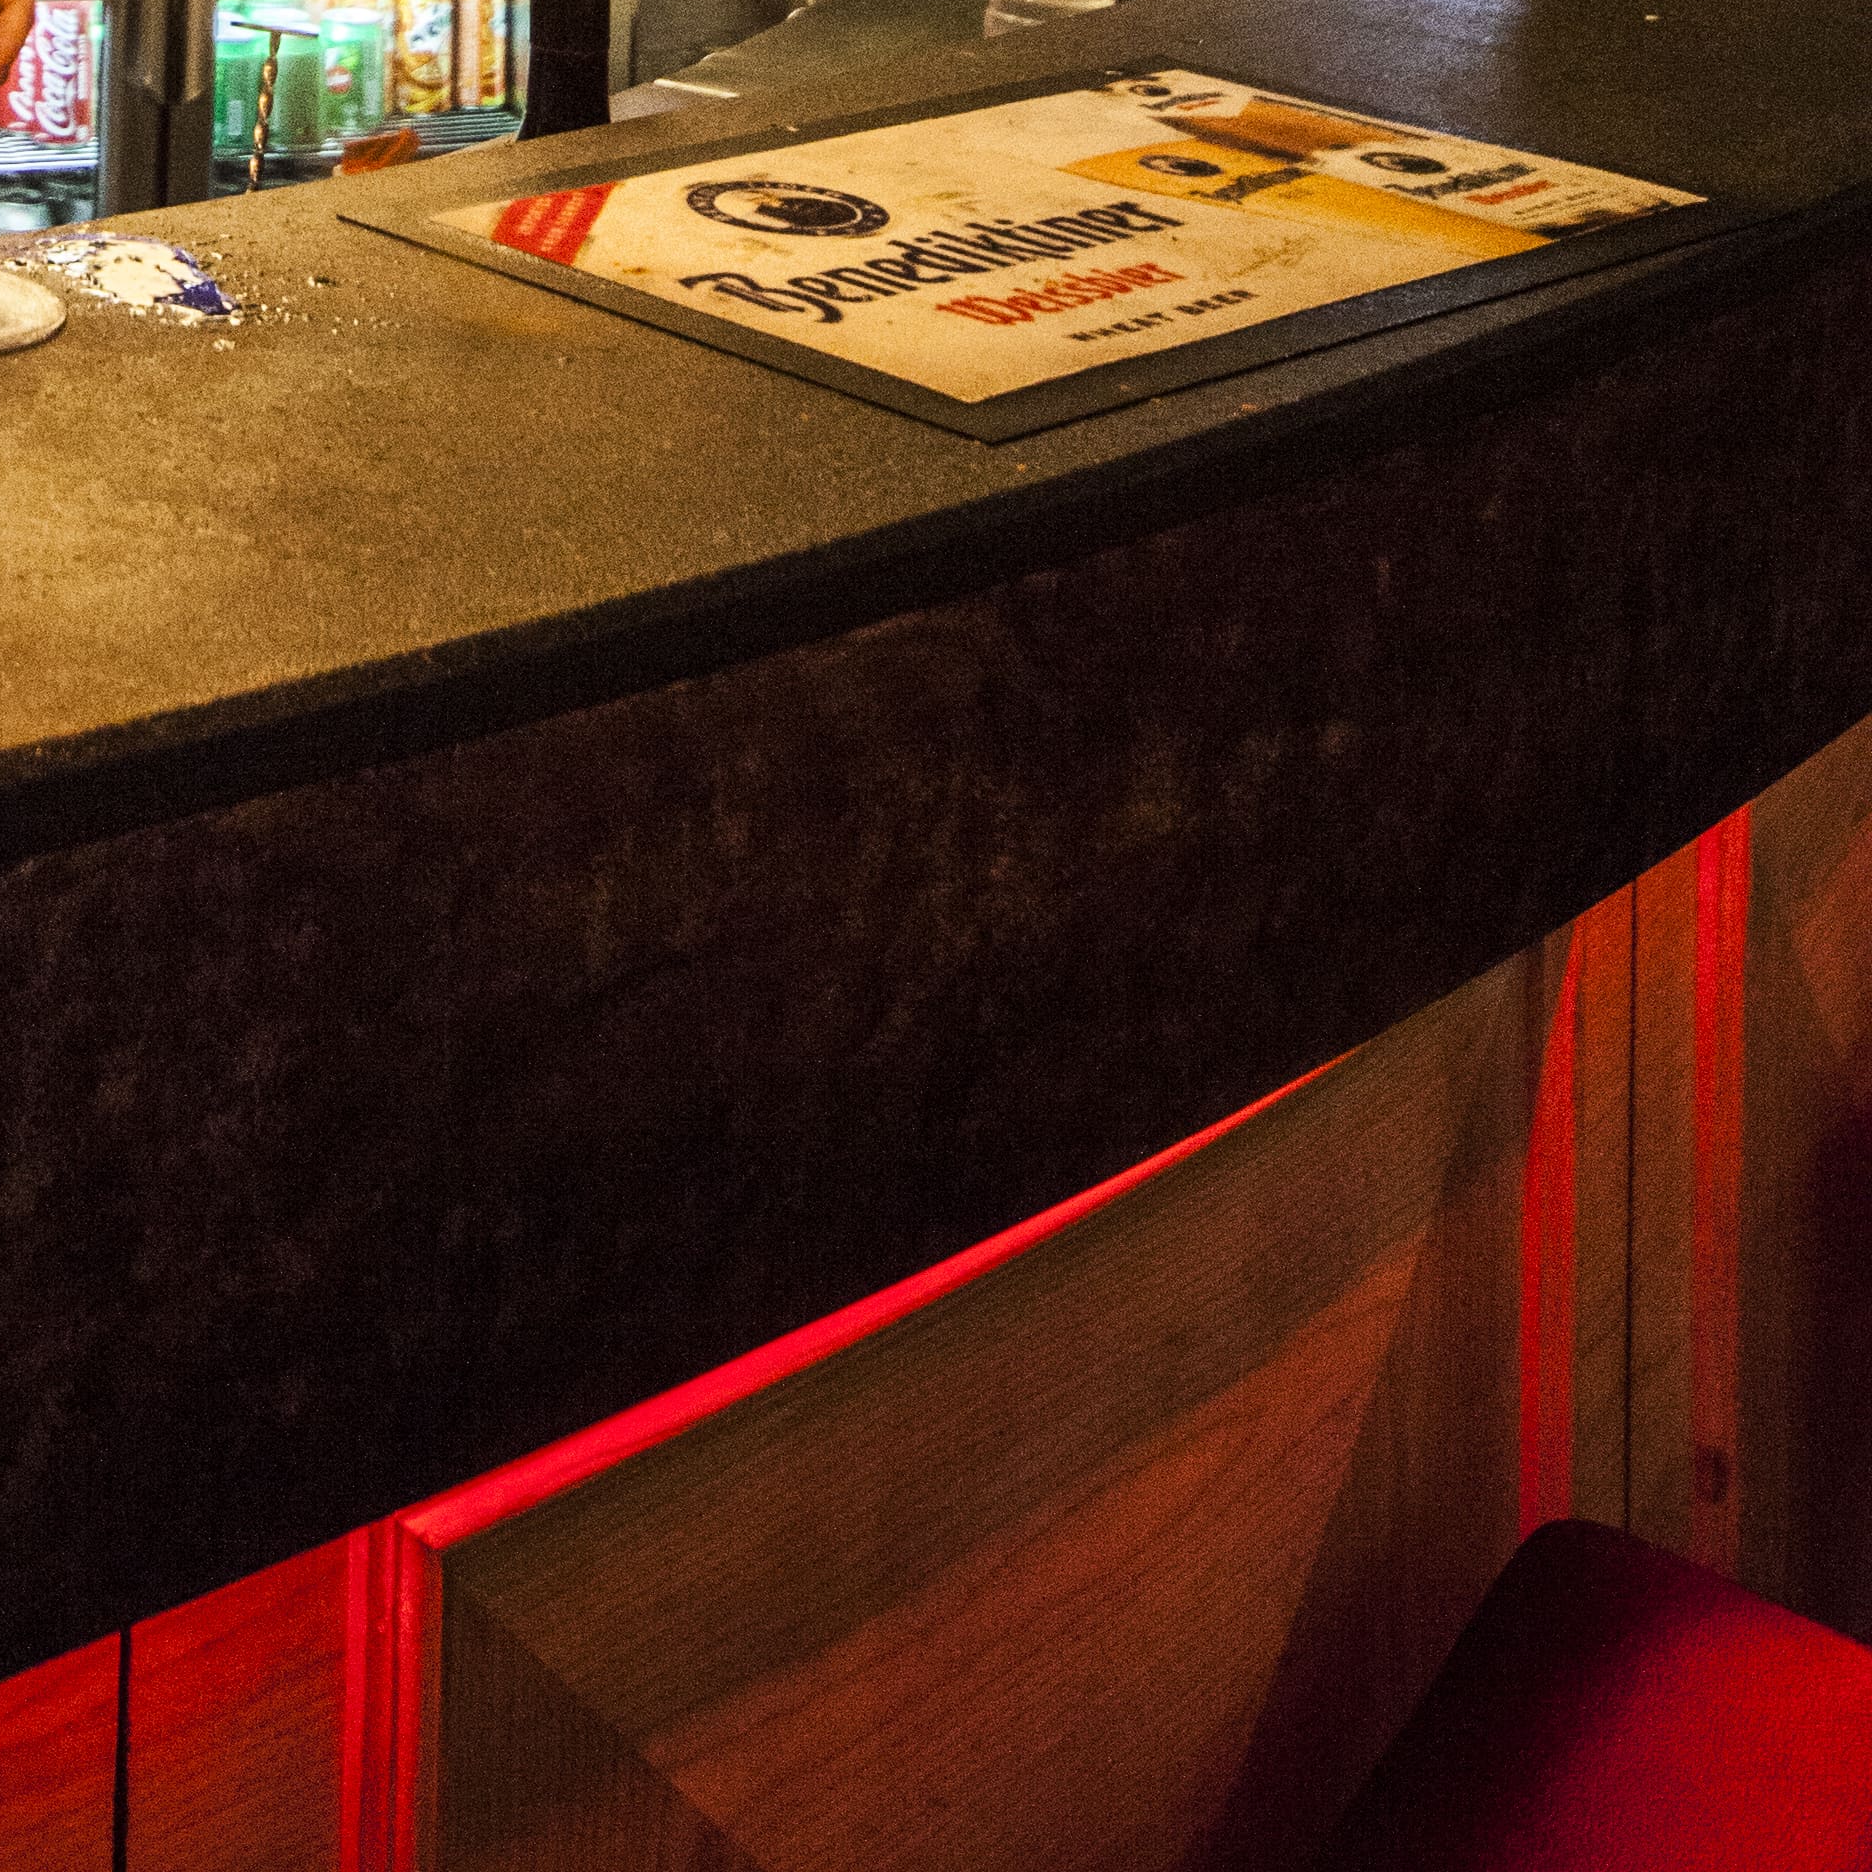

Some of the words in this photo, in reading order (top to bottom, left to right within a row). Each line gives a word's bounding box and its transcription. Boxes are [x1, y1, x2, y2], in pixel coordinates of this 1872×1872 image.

[678, 199, 1186, 325] Benediktiner
[934, 261, 1188, 327] Weissbier
[1066, 309, 1174, 343] WHEAT
[1188, 287, 1261, 316] BEER
